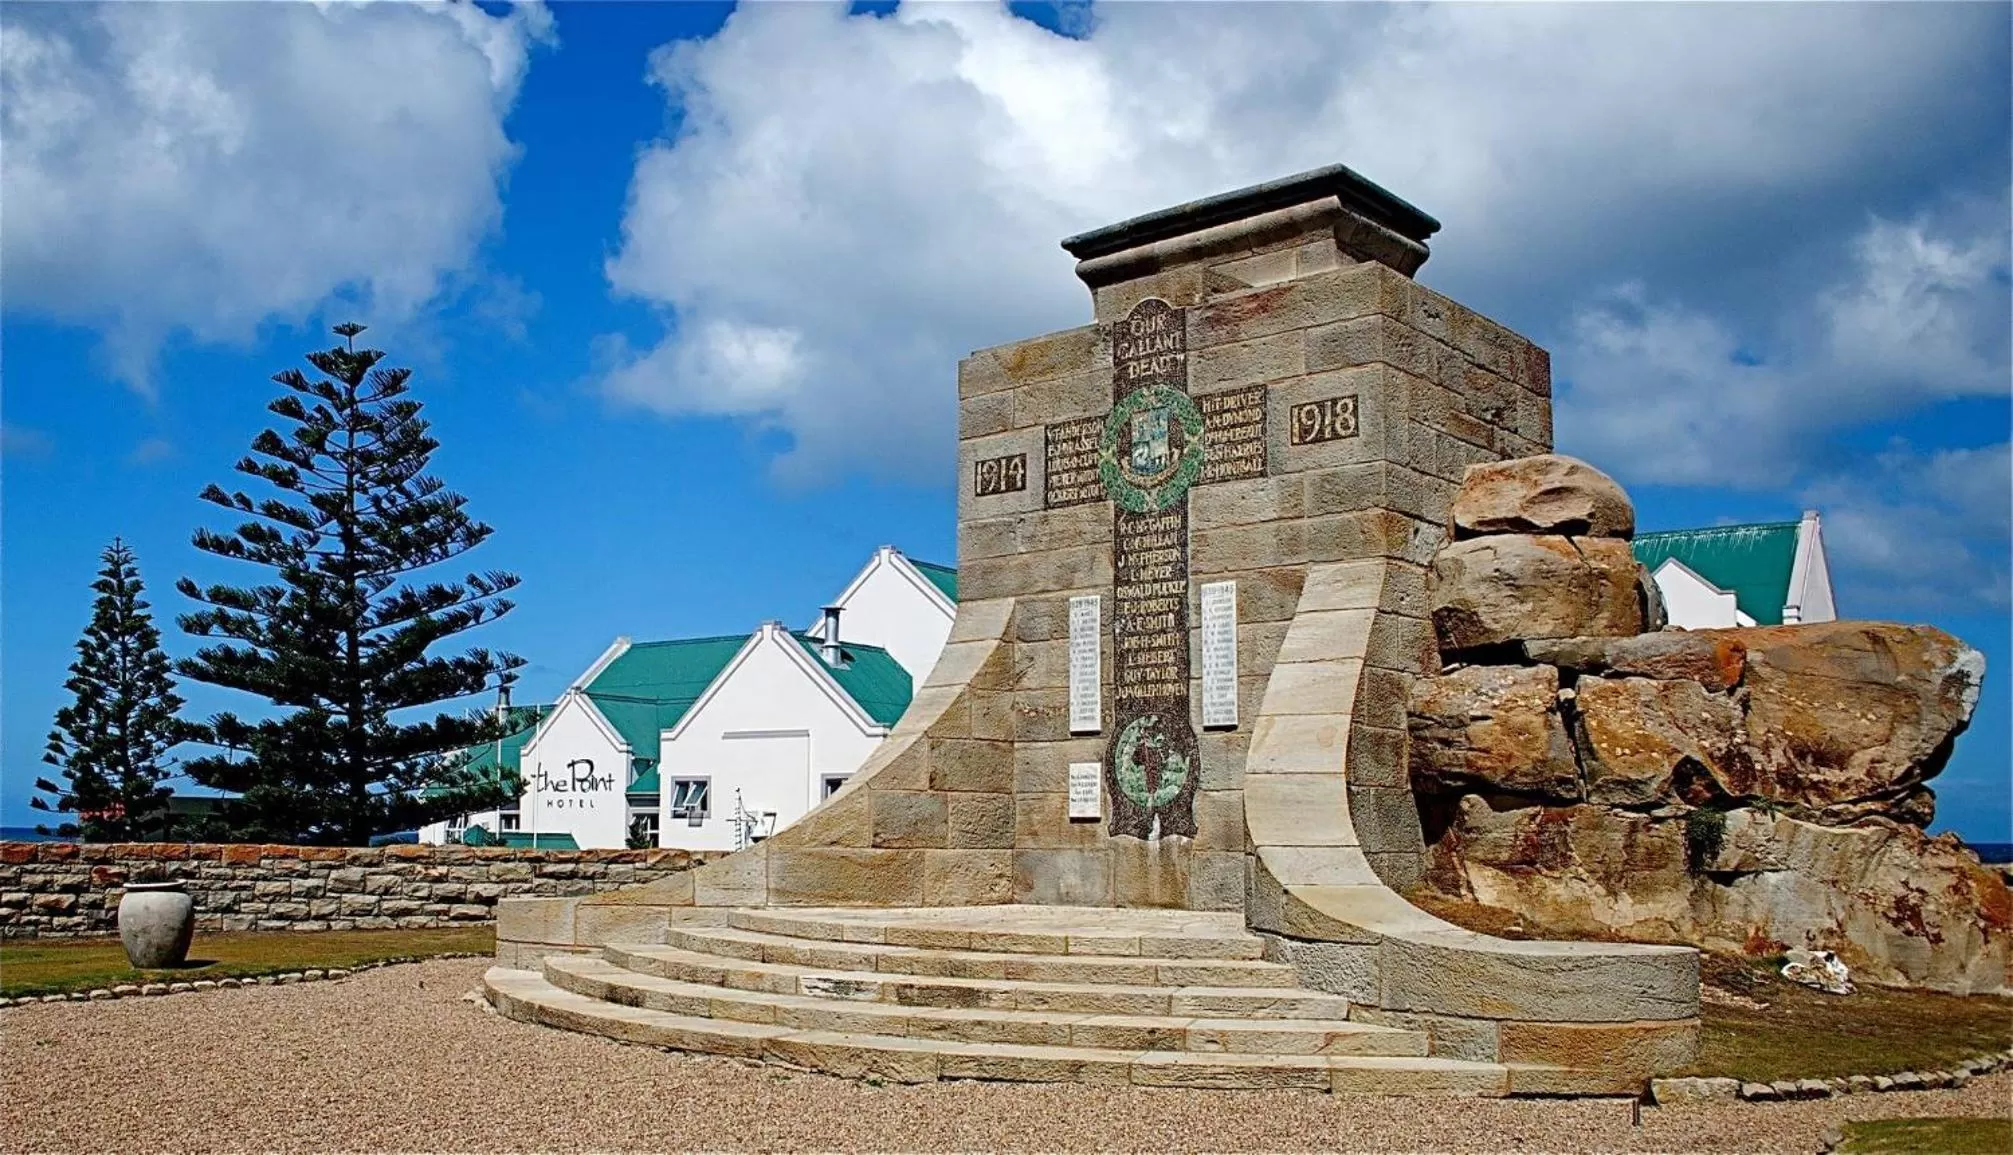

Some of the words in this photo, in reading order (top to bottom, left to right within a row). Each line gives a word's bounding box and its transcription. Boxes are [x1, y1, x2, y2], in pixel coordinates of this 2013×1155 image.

[1130, 312, 1167, 336] OUR
[1117, 331, 1182, 360] GALLANT
[1292, 398, 1355, 443] 1918
[976, 458, 1024, 494] 1914
[531, 762, 568, 792] the
[567, 758, 615, 793] Point
[547, 798, 594, 808] HOTEL
